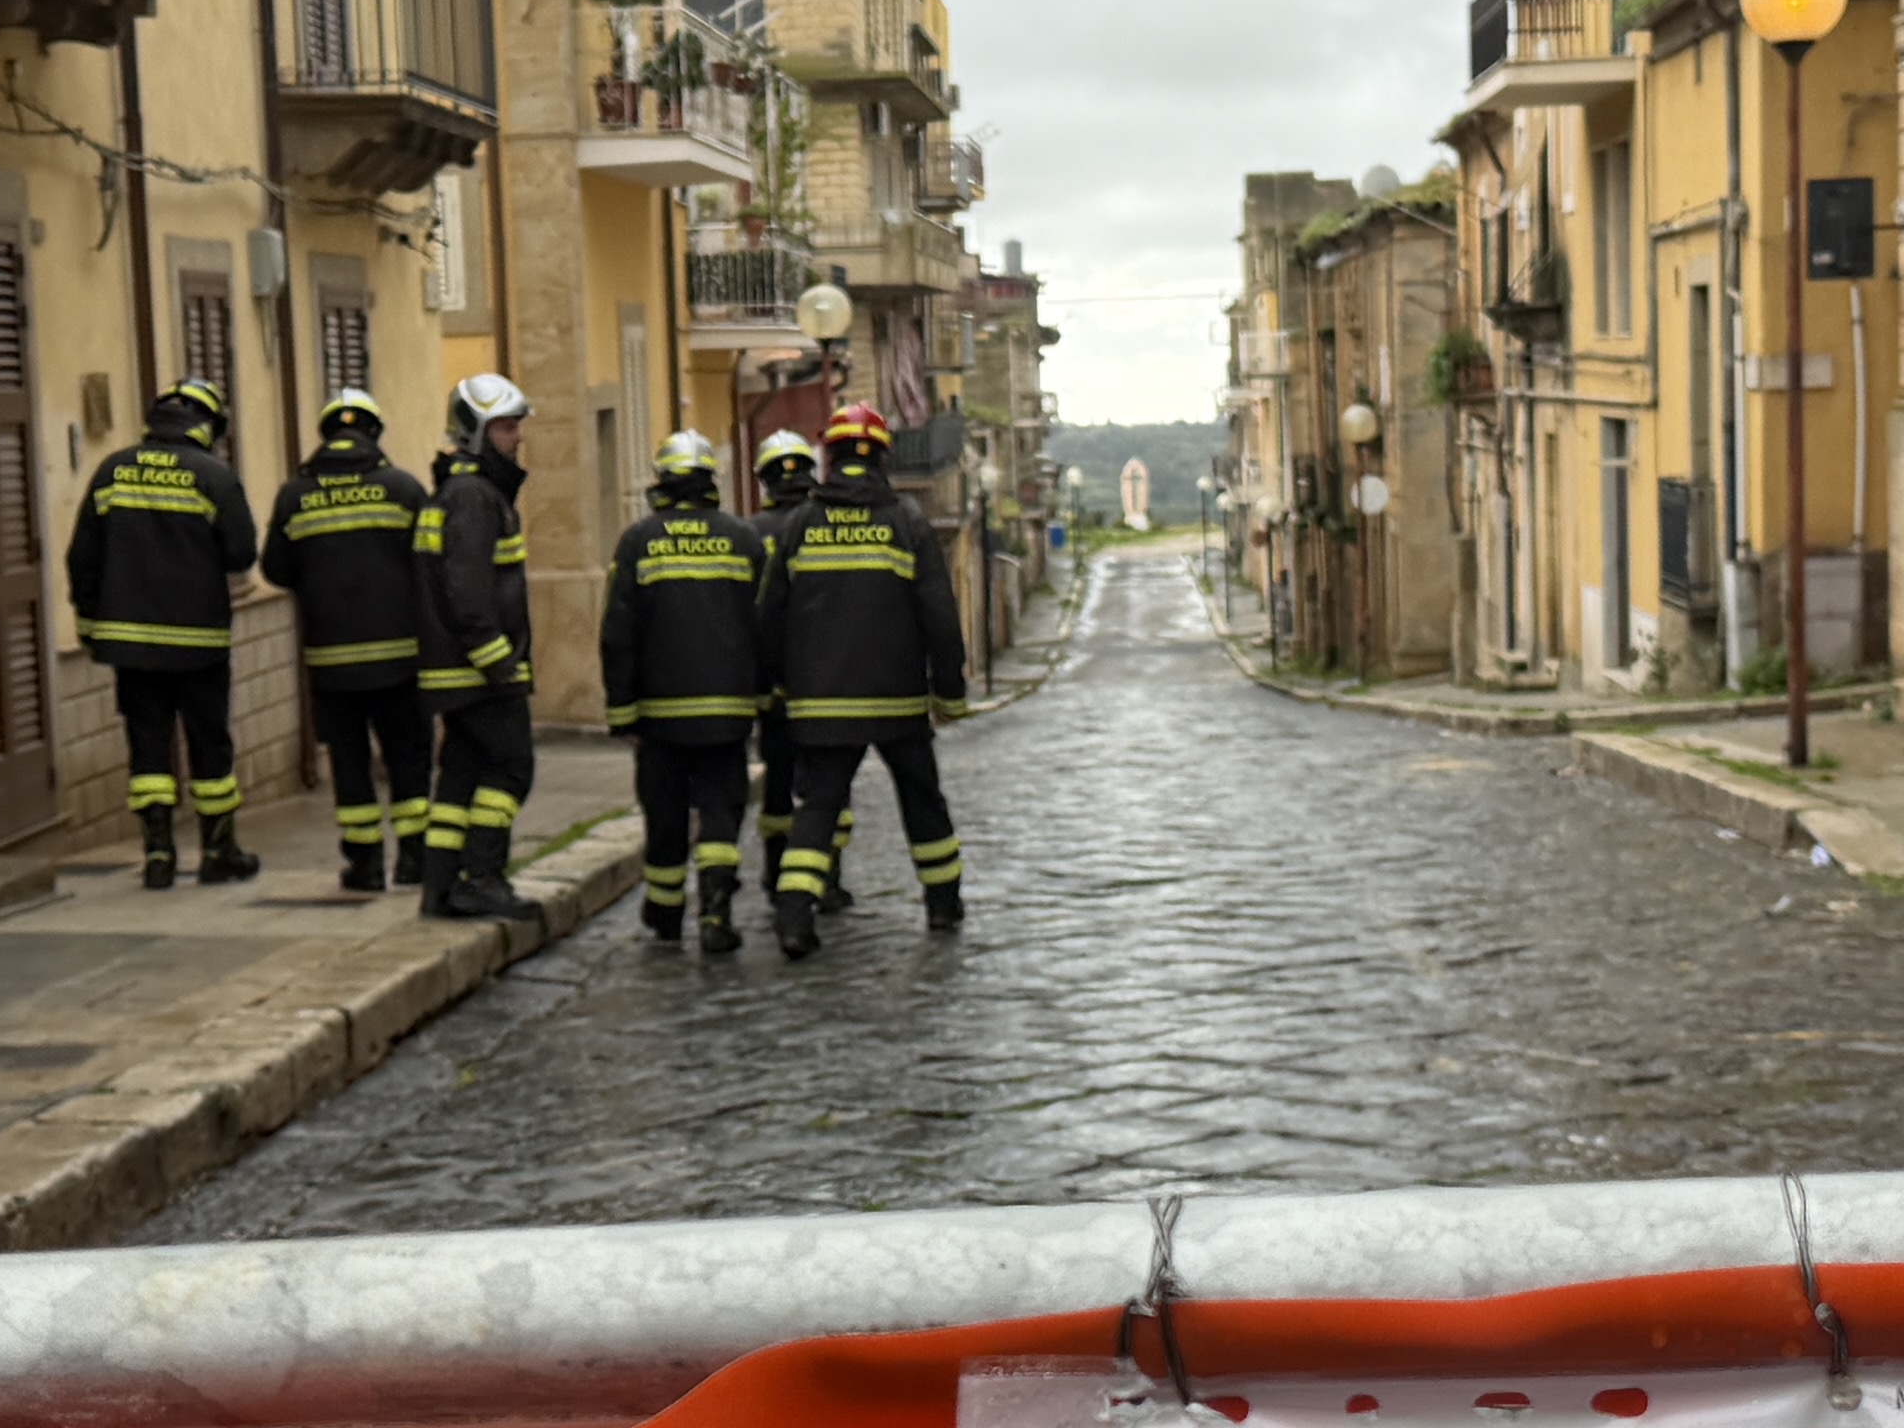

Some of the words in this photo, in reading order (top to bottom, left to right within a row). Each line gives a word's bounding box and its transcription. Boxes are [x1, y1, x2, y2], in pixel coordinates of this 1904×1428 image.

[114, 465, 139, 481] DEL
[142, 467, 195, 486] FUOCO
[301, 491, 327, 510] DEL
[331, 484, 387, 504] FUOCO
[825, 506, 871, 524] VIGILI
[664, 520, 709, 536] VIGILI
[805, 525, 834, 543] DEL
[836, 524, 893, 543] FUOCO
[648, 538, 675, 555] DEL
[677, 536, 732, 554] FUOCO
